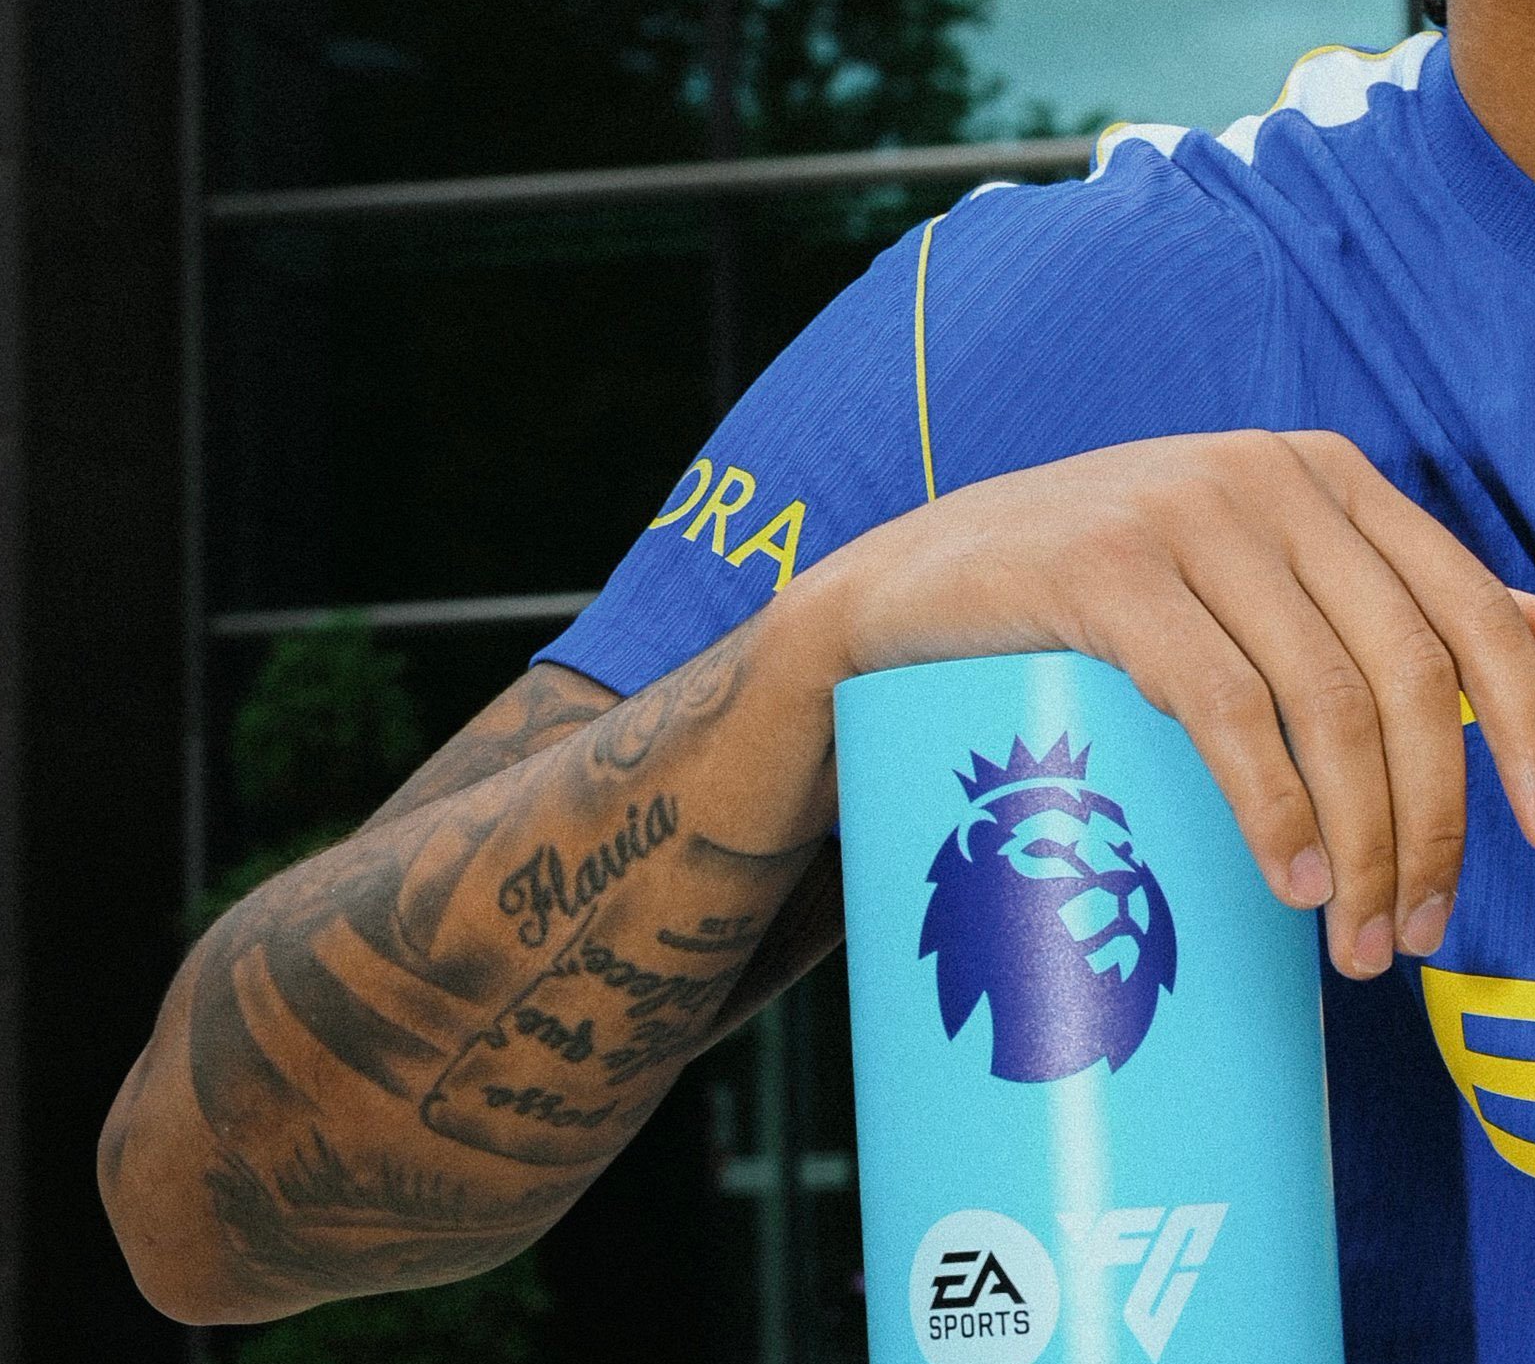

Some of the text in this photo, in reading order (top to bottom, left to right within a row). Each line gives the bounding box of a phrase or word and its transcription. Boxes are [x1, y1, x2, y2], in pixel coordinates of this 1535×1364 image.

[499, 792, 679, 949] Flavia
[929, 1249, 1028, 1311] EA
[928, 1309, 1031, 1340] SPORTS
